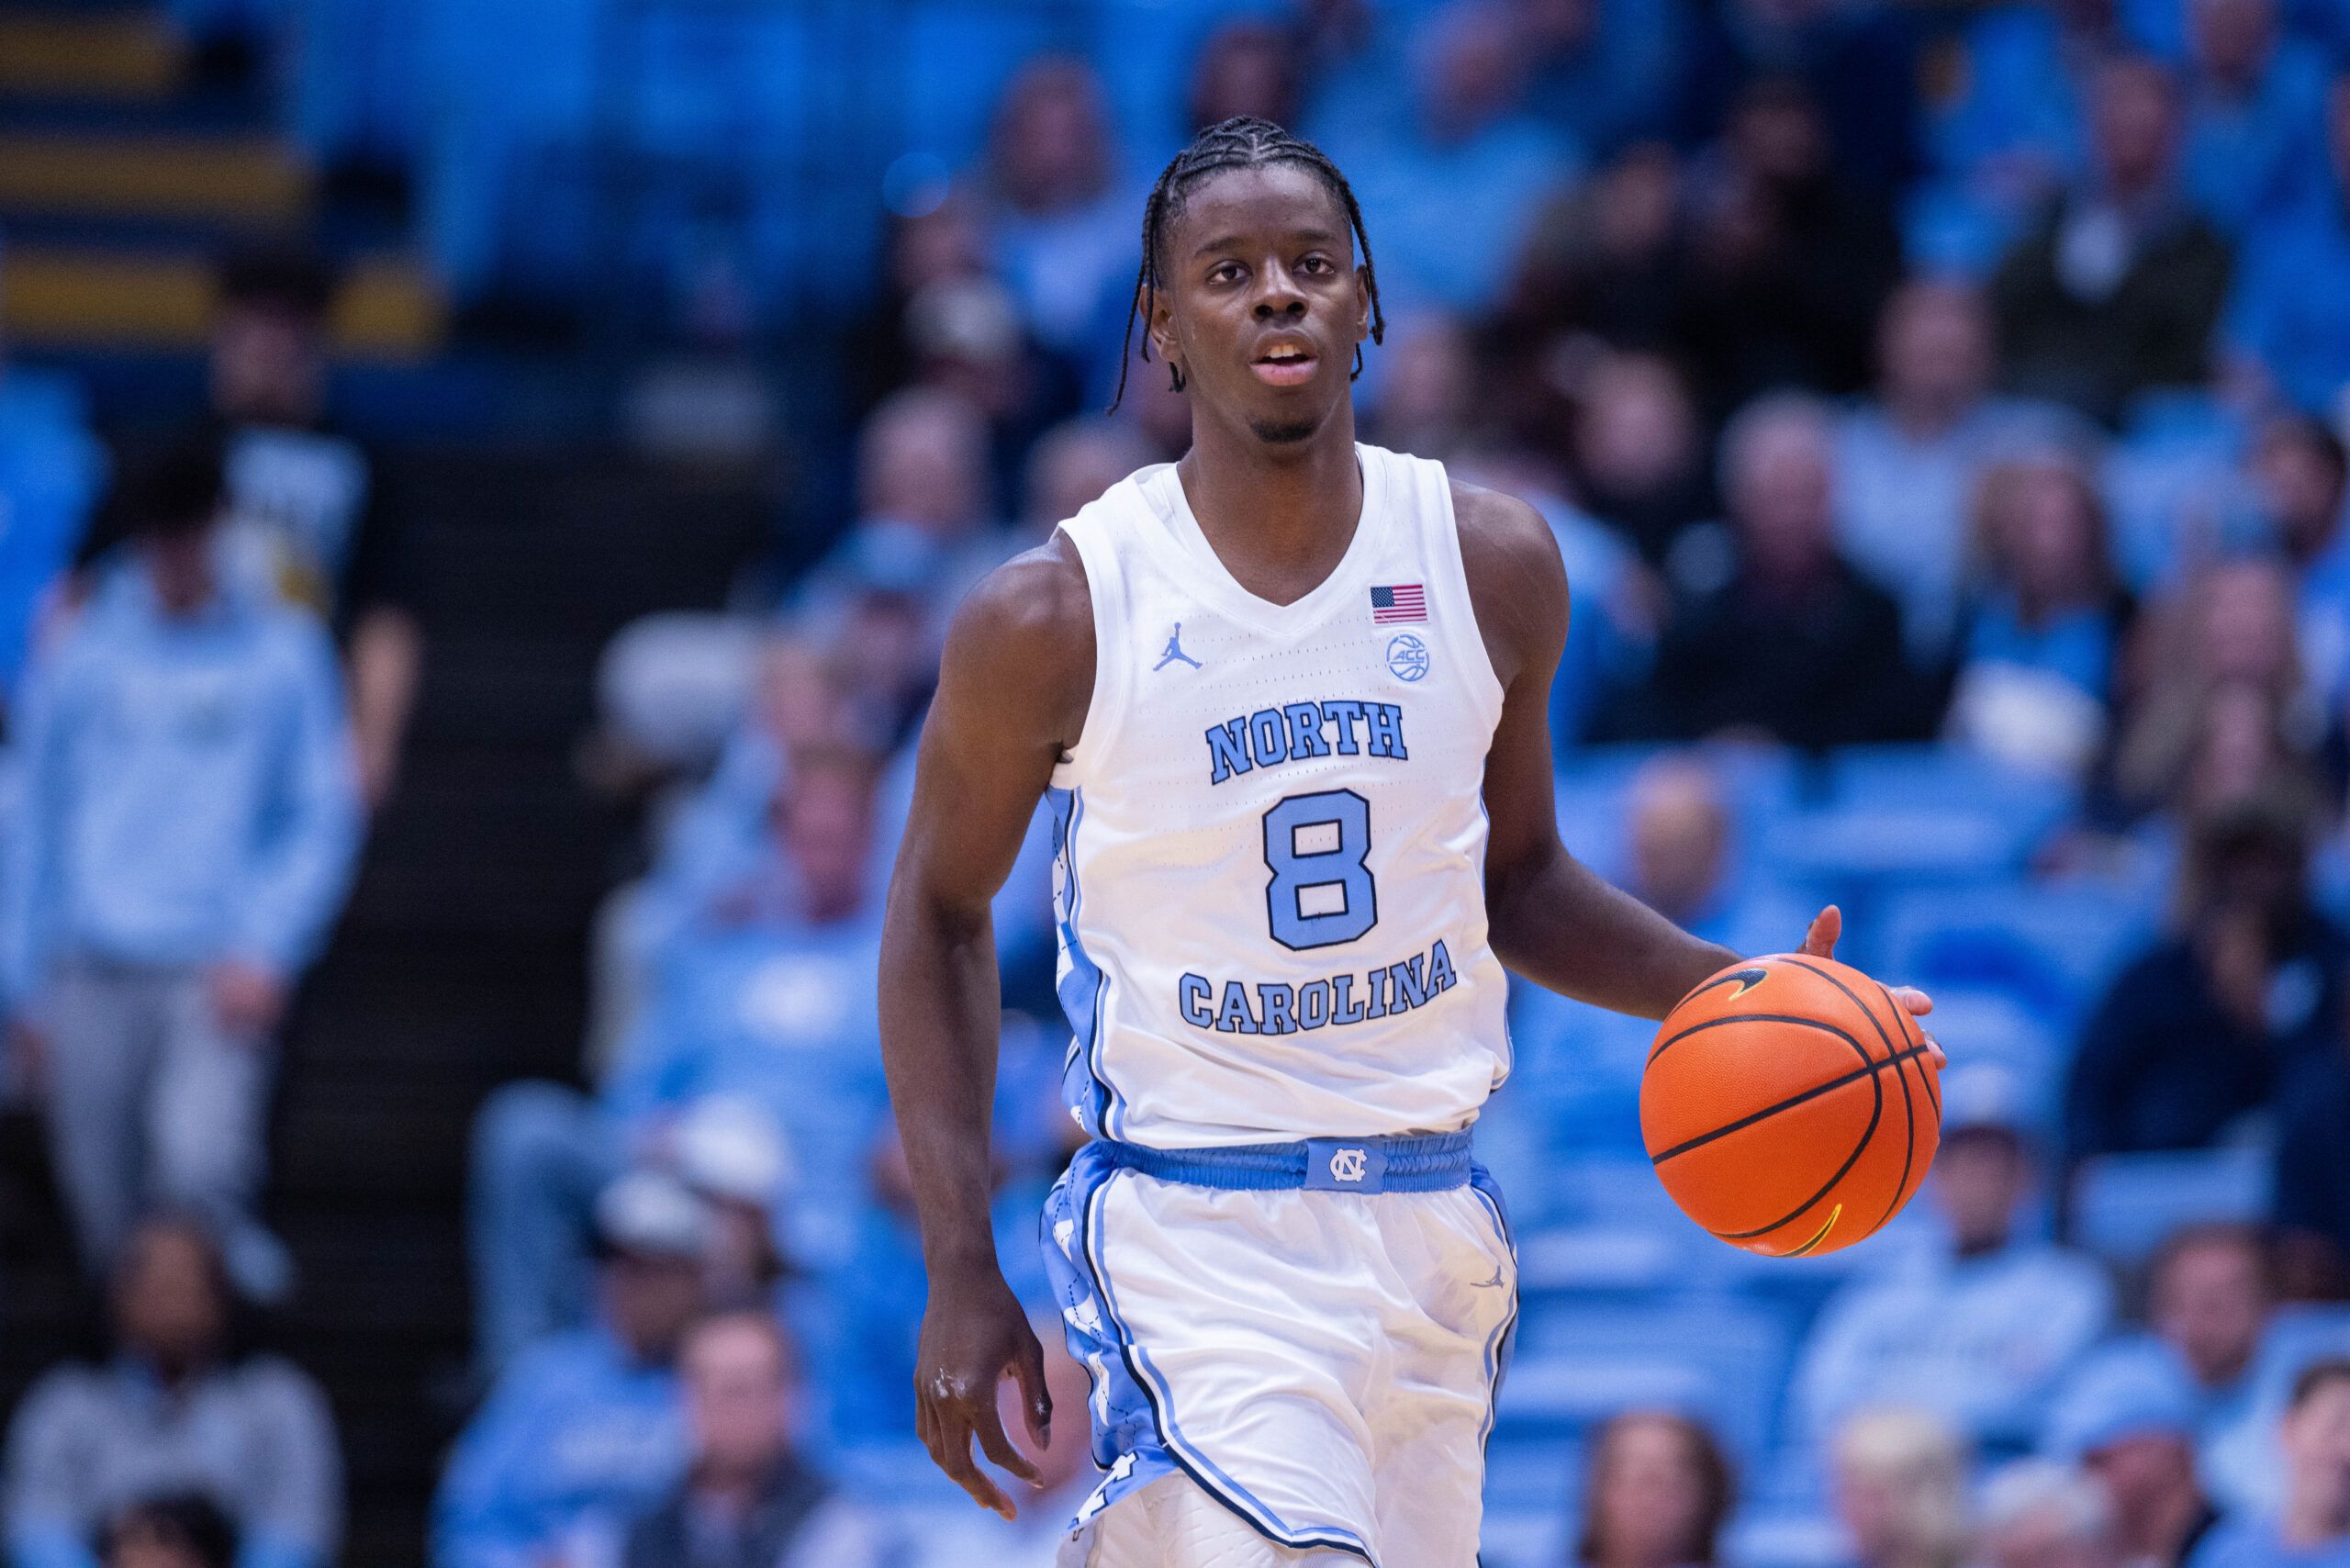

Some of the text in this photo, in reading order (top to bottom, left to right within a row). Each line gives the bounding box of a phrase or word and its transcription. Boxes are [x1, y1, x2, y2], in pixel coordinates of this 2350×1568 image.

[1393, 649, 1426, 660] ACC
[1205, 700, 1408, 785] NORTH
[1262, 788, 1378, 951] 8
[1179, 938, 1457, 1035] CAROLINA
